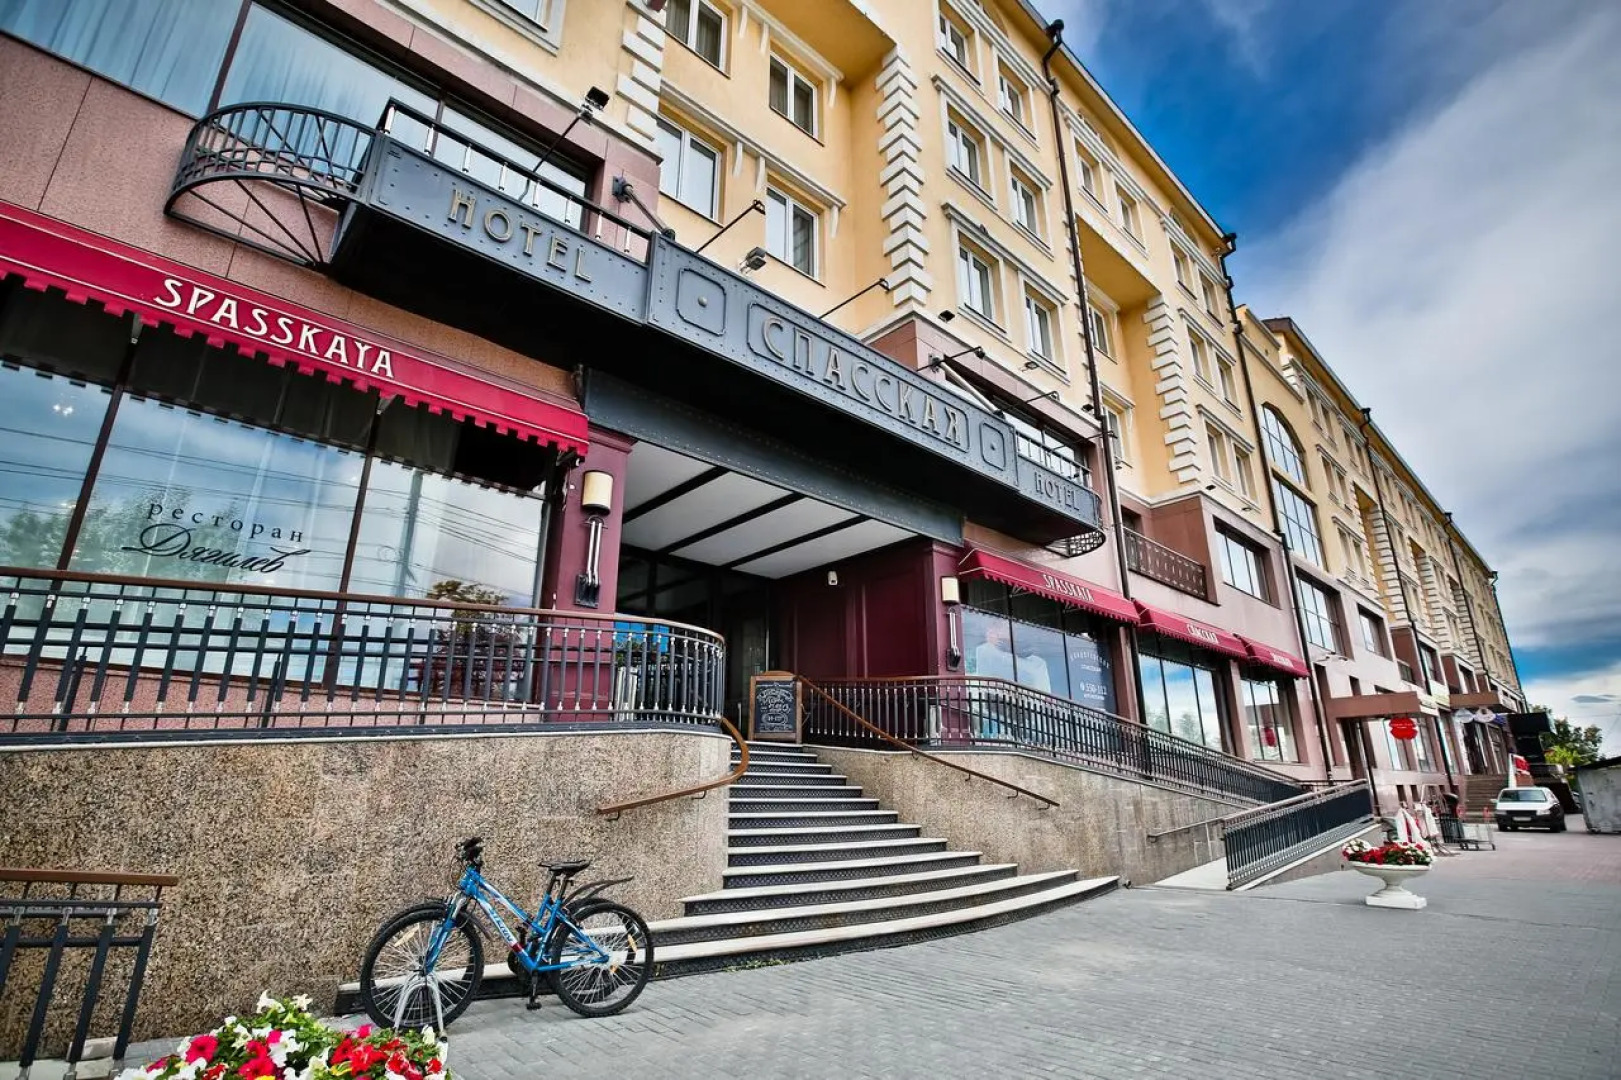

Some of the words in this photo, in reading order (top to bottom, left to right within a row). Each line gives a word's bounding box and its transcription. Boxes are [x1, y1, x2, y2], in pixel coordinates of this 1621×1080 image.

[447, 188, 592, 283] HOTEL
[152, 278, 395, 379] SPASSKAYA
[761, 316, 961, 446] СПАССКАЯ
[147, 502, 303, 543] ресторан
[1034, 471, 1080, 511] HOTEL
[121, 523, 312, 573] Дягилев
